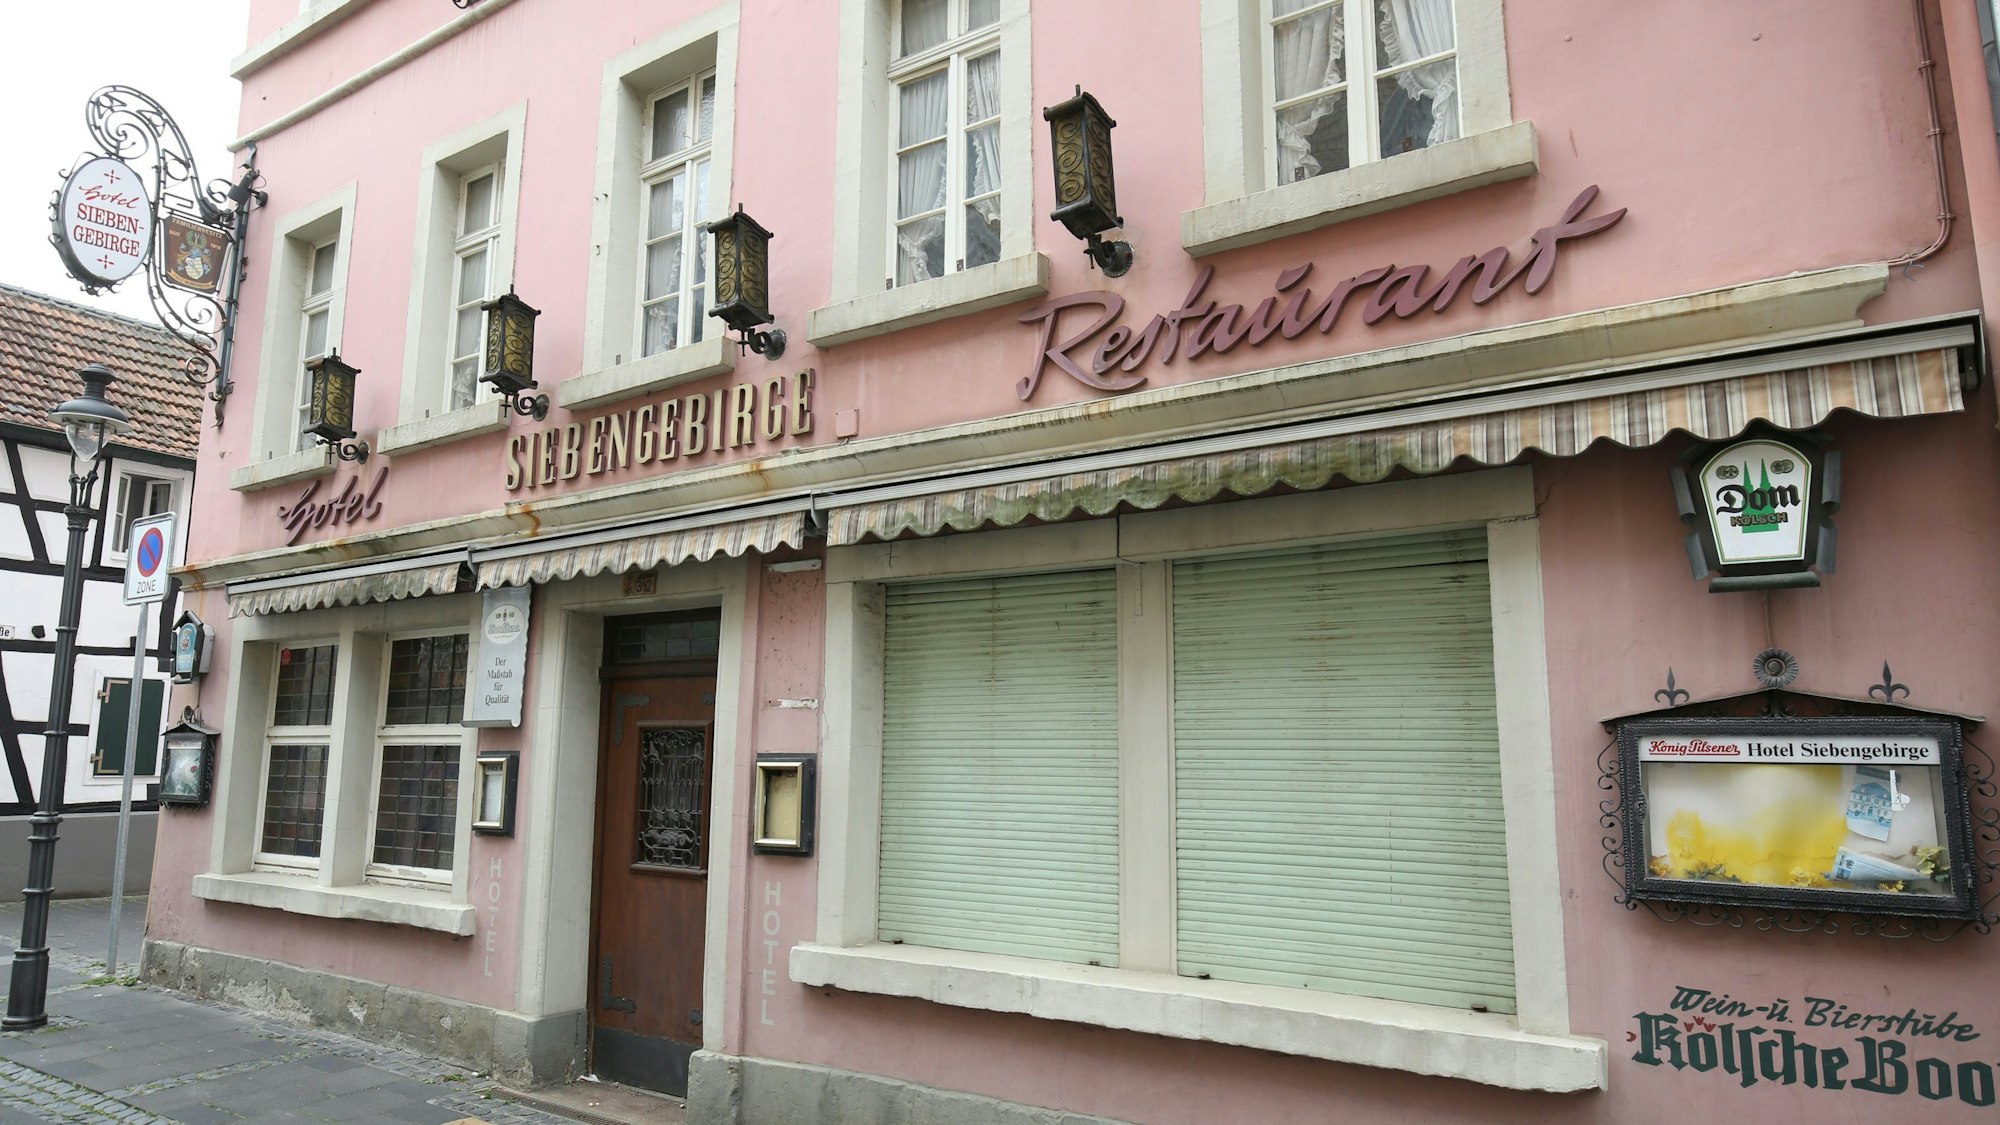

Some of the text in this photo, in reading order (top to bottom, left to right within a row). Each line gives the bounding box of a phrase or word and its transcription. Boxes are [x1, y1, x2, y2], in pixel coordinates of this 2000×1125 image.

[77, 203, 145, 235] SIEBEN-
[172, 218, 223, 239] FAMILIENBESITZ
[73, 225, 140, 257] GEBIRGE
[505, 368, 816, 491] SIEBENGEBIRGE
[1716, 484, 1801, 516] Dom
[1730, 511, 1788, 527] KÖLSCH
[137, 579, 156, 594] ZONE
[495, 657, 507, 667] Der
[488, 669, 513, 679] Maßstab
[493, 682, 503, 692] für
[485, 694, 510, 706] Qualität
[1648, 739, 1741, 756] König Pilsener
[1747, 743, 1930, 760] Hotel Siebengebirge
[484, 857, 502, 977] HOTEL
[761, 881, 782, 1026] HOTEL
[1850, 1036, 2000, 1107] Boo
